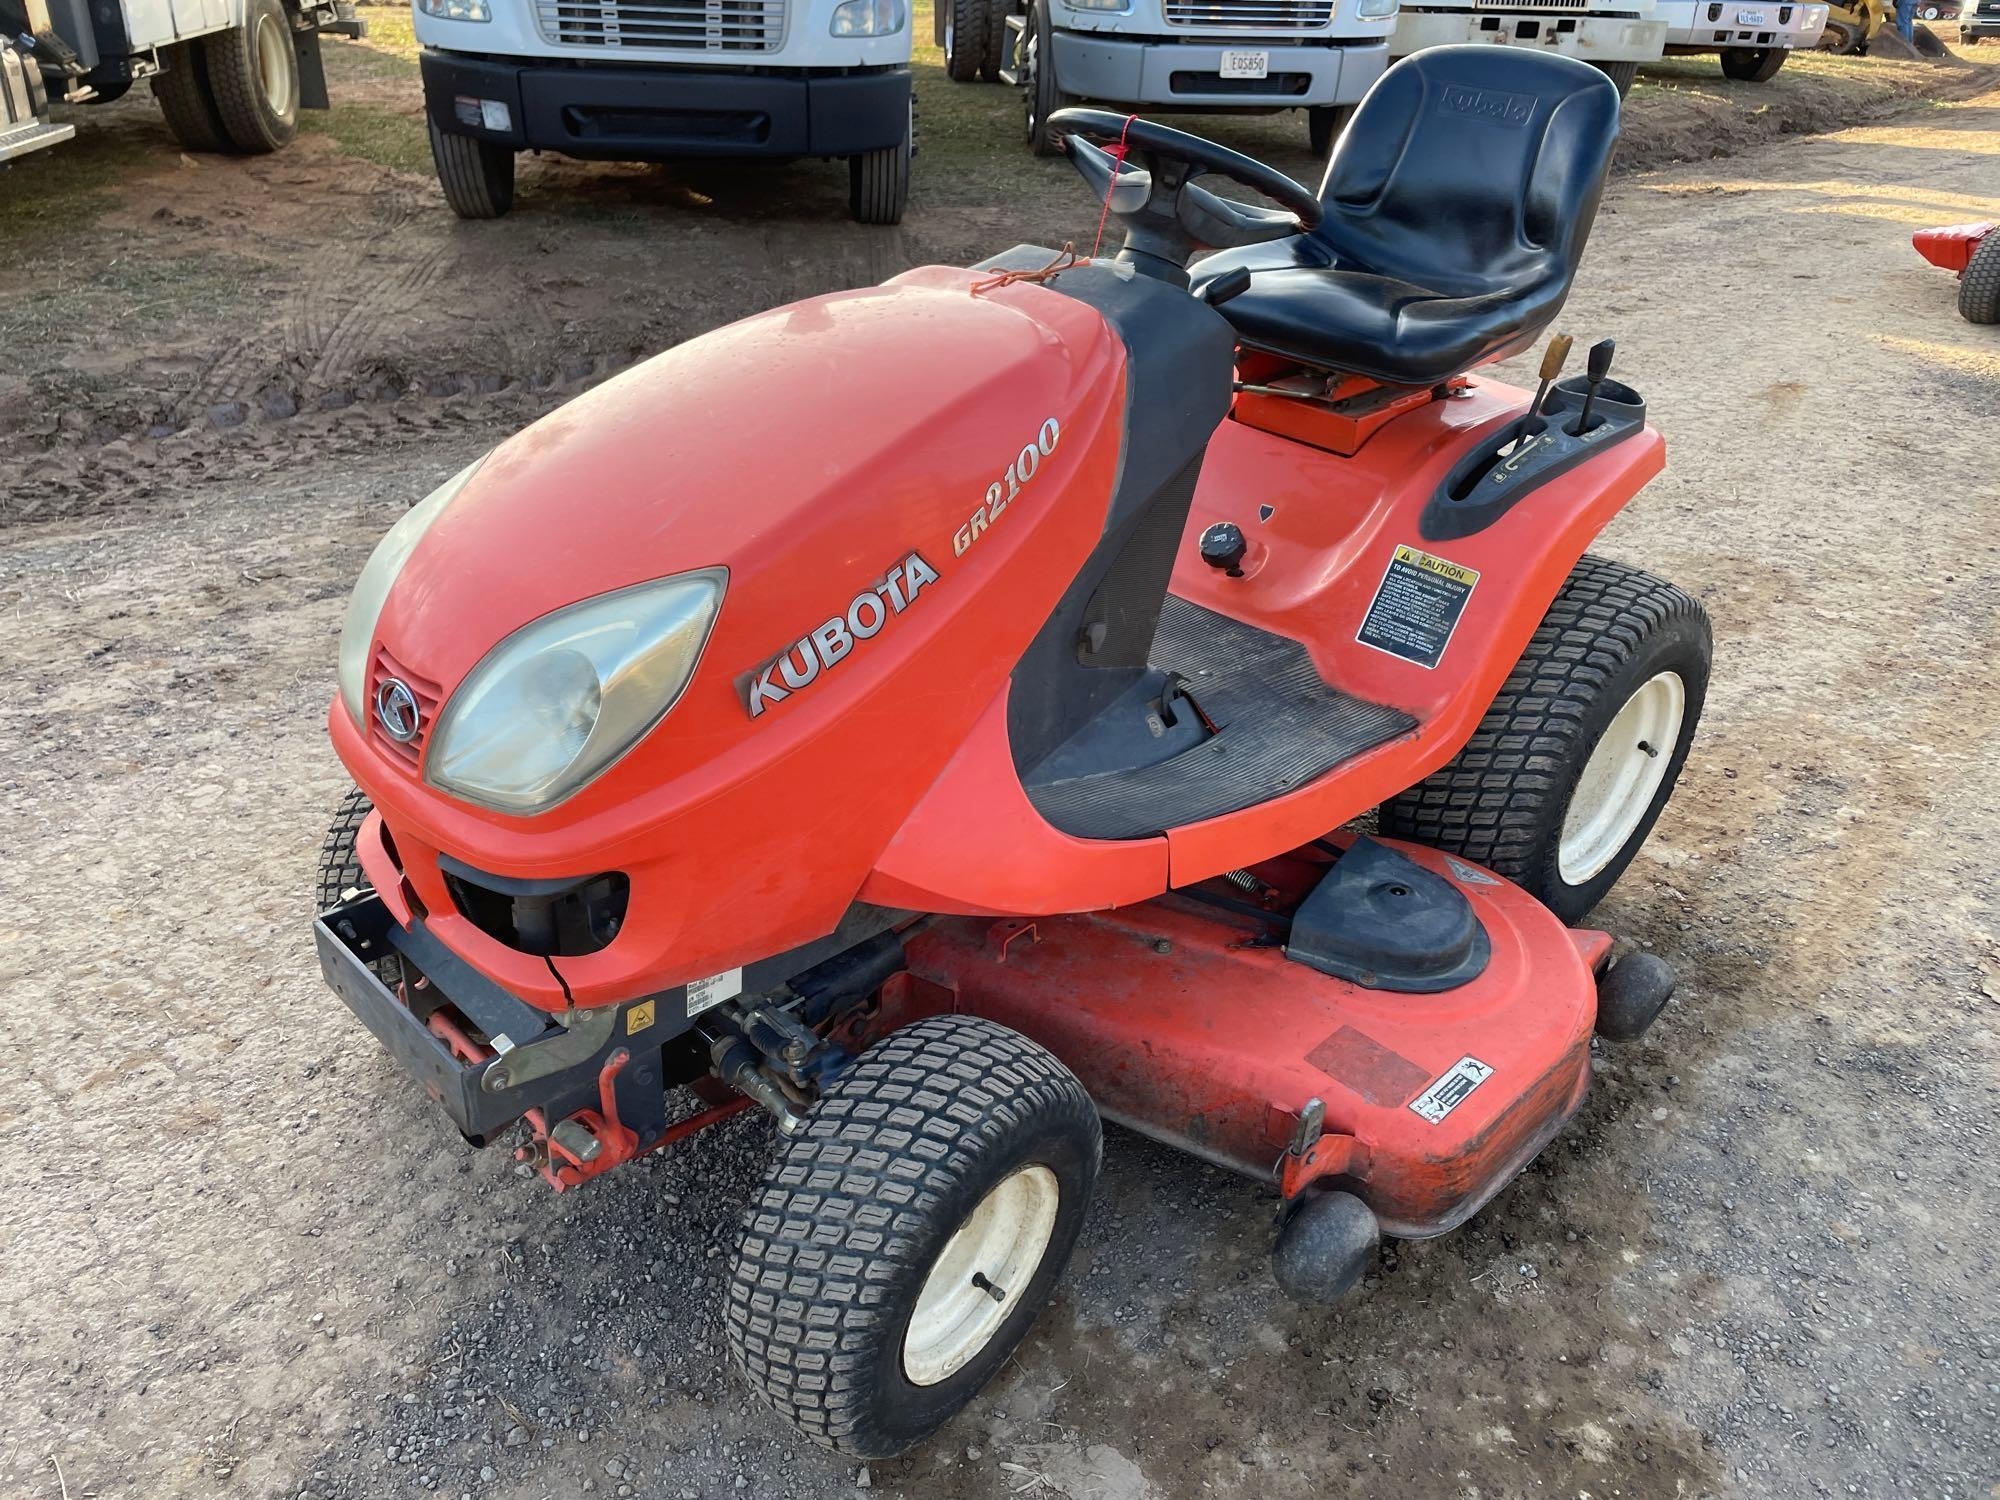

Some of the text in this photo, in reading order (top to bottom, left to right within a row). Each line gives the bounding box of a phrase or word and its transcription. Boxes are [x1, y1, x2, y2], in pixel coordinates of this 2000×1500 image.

[952, 417, 1061, 558] GR2100
[749, 551, 941, 719] KUBOTA
[1401, 566, 1418, 576] AVOID
[1417, 572, 1445, 586] PERSONAL
[1445, 582, 1466, 593] INJURY
